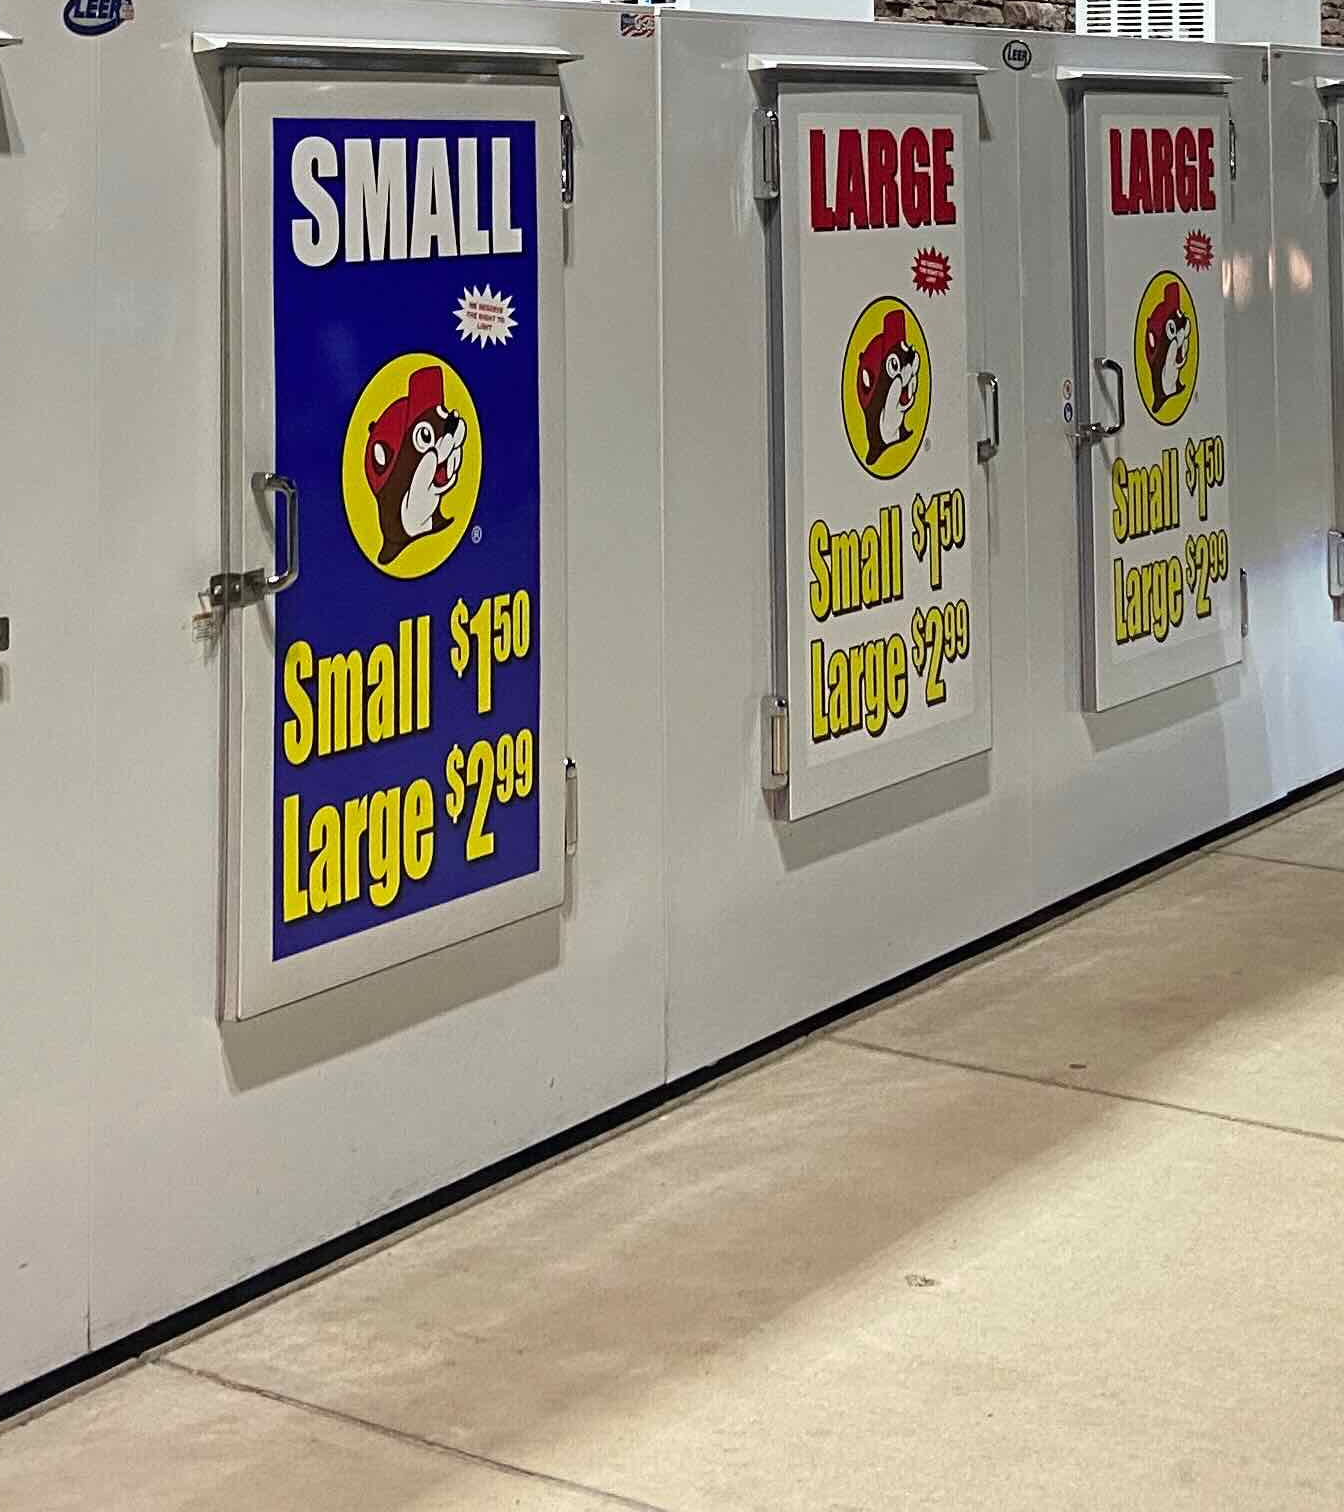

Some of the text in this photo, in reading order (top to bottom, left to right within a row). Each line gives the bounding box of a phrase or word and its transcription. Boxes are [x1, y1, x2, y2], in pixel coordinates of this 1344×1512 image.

[291, 136, 523, 267] SMALL
[809, 127, 956, 232] LARGE
[1109, 126, 1216, 216] LARGE
[1111, 448, 1180, 543] Small
[809, 505, 903, 622] Small
[1113, 556, 1183, 645] Large
[283, 615, 431, 765] Small
[811, 633, 908, 743] Large
[282, 779, 434, 923] Large
